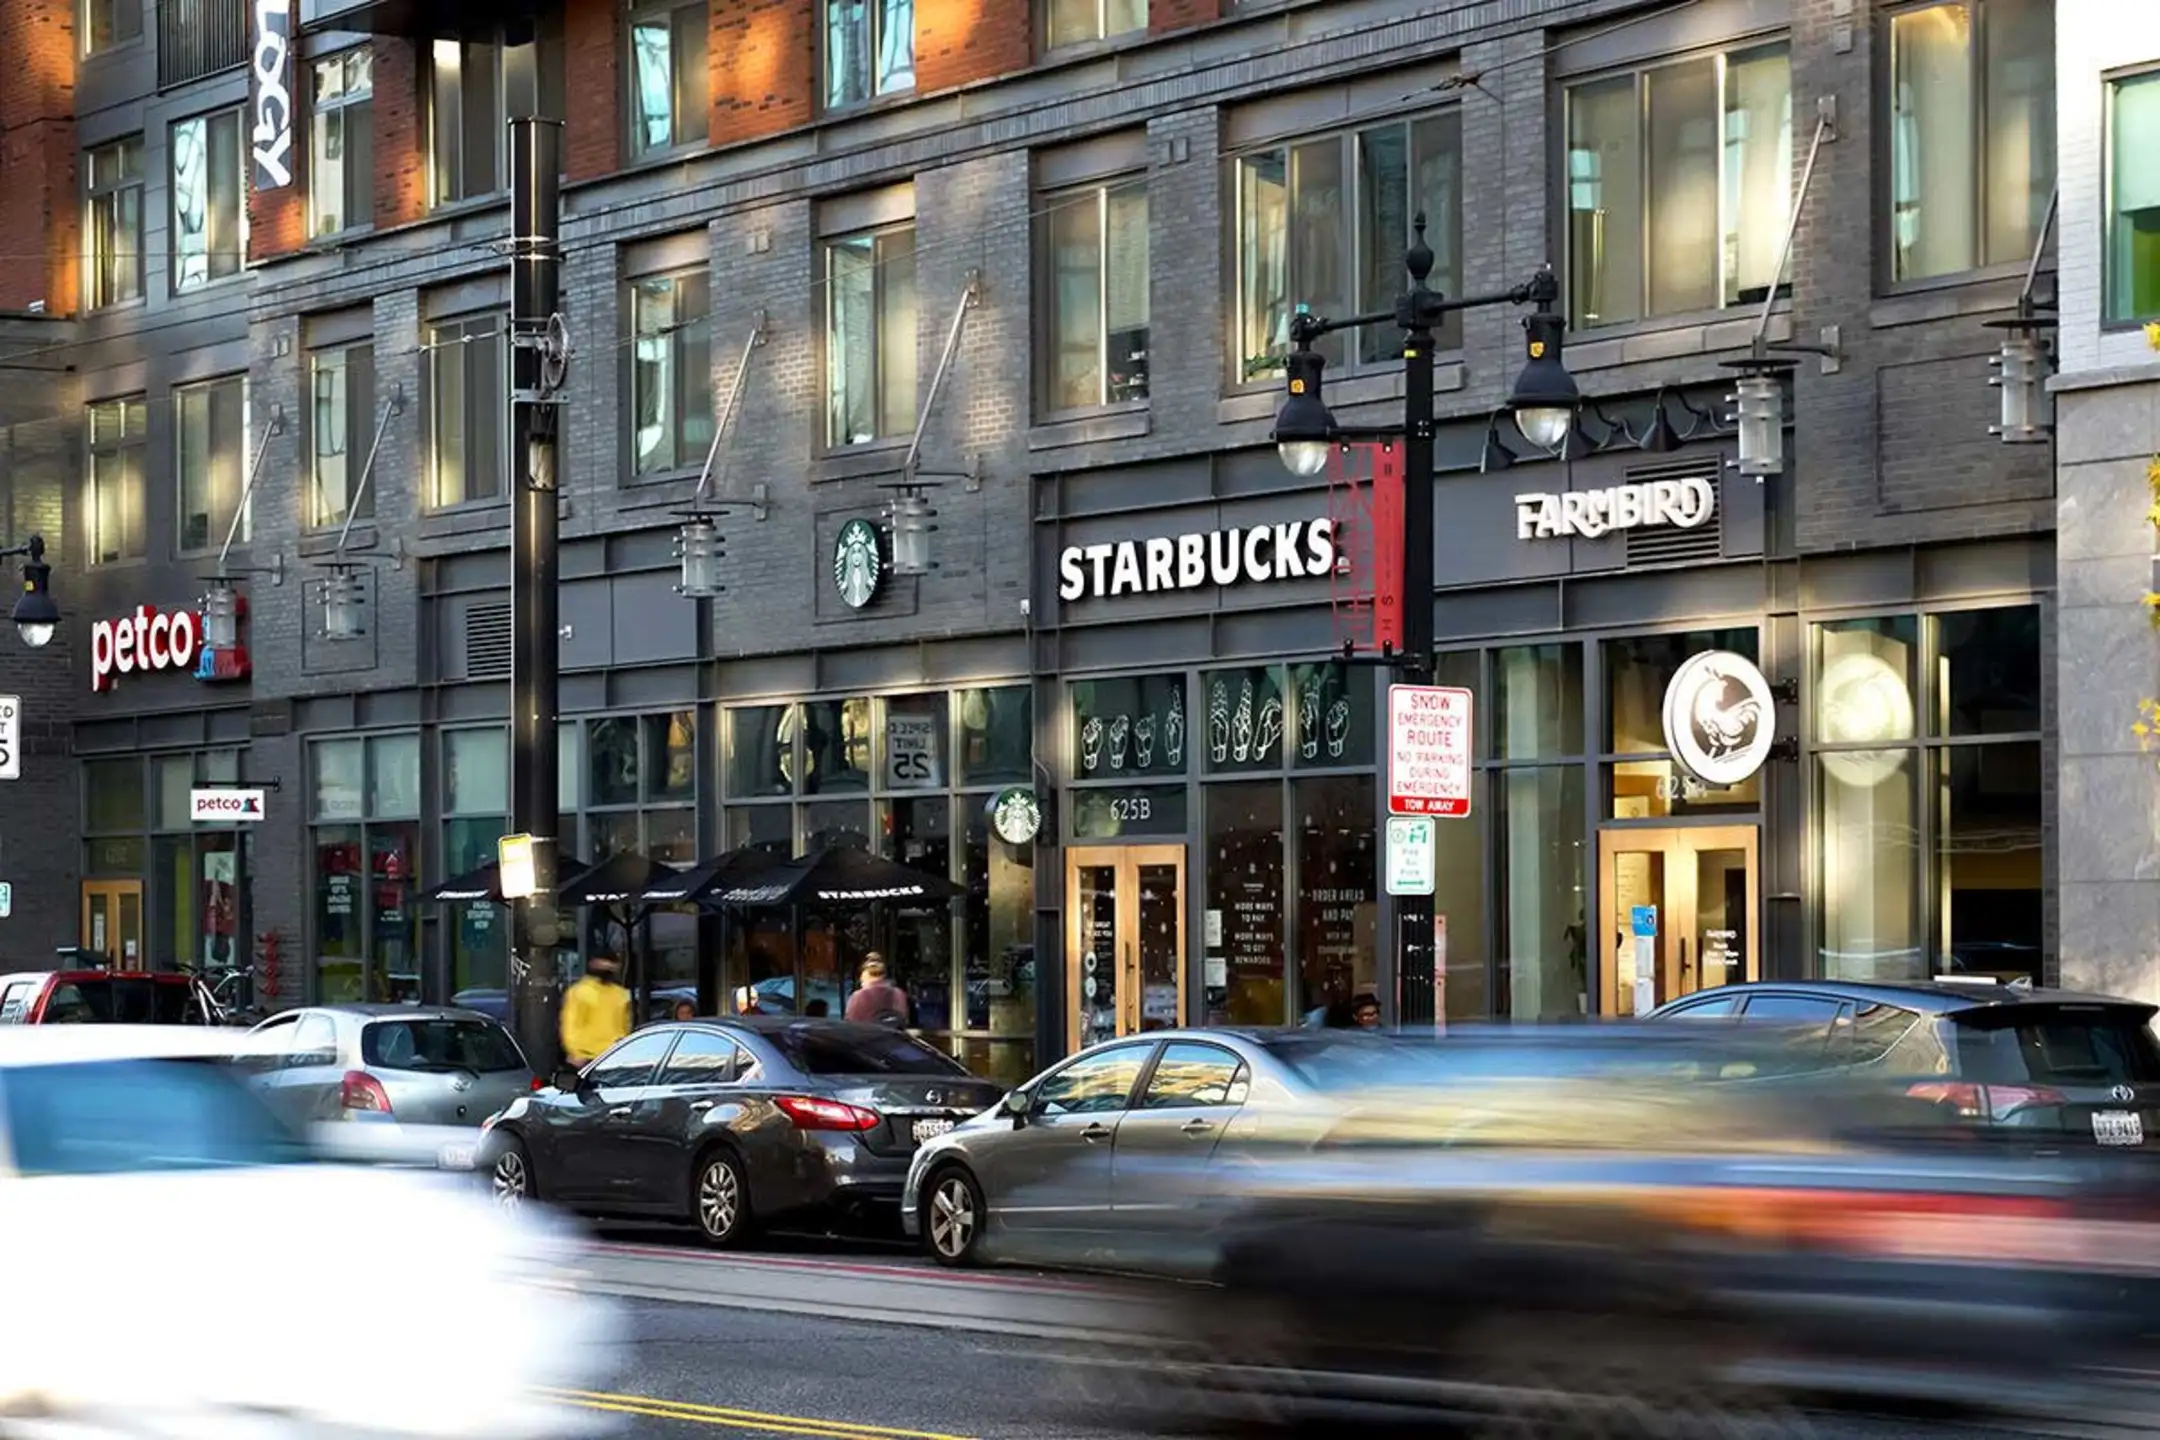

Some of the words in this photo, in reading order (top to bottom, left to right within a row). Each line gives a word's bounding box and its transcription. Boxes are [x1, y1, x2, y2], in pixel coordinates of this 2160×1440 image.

[1515, 477, 1715, 539] FARMBIRD
[1060, 517, 1333, 601] STARBUCKS
[92, 604, 193, 692] petco
[1411, 693, 1450, 710] SNOW
[1398, 712, 1462, 728] EMERGENCY
[1407, 729, 1452, 748] ROUTE
[1397, 751, 1412, 763] NO
[1416, 752, 1465, 767] PARKING
[1409, 766, 1450, 780] DURING
[1397, 781, 1461, 795] EMERGENCY
[198, 797, 242, 812] petco
[1110, 799, 1151, 821] 625B
[1404, 799, 1425, 811] TOW
[1427, 799, 1455, 812] AWAY
[817, 885, 925, 900] STARBUCKS
